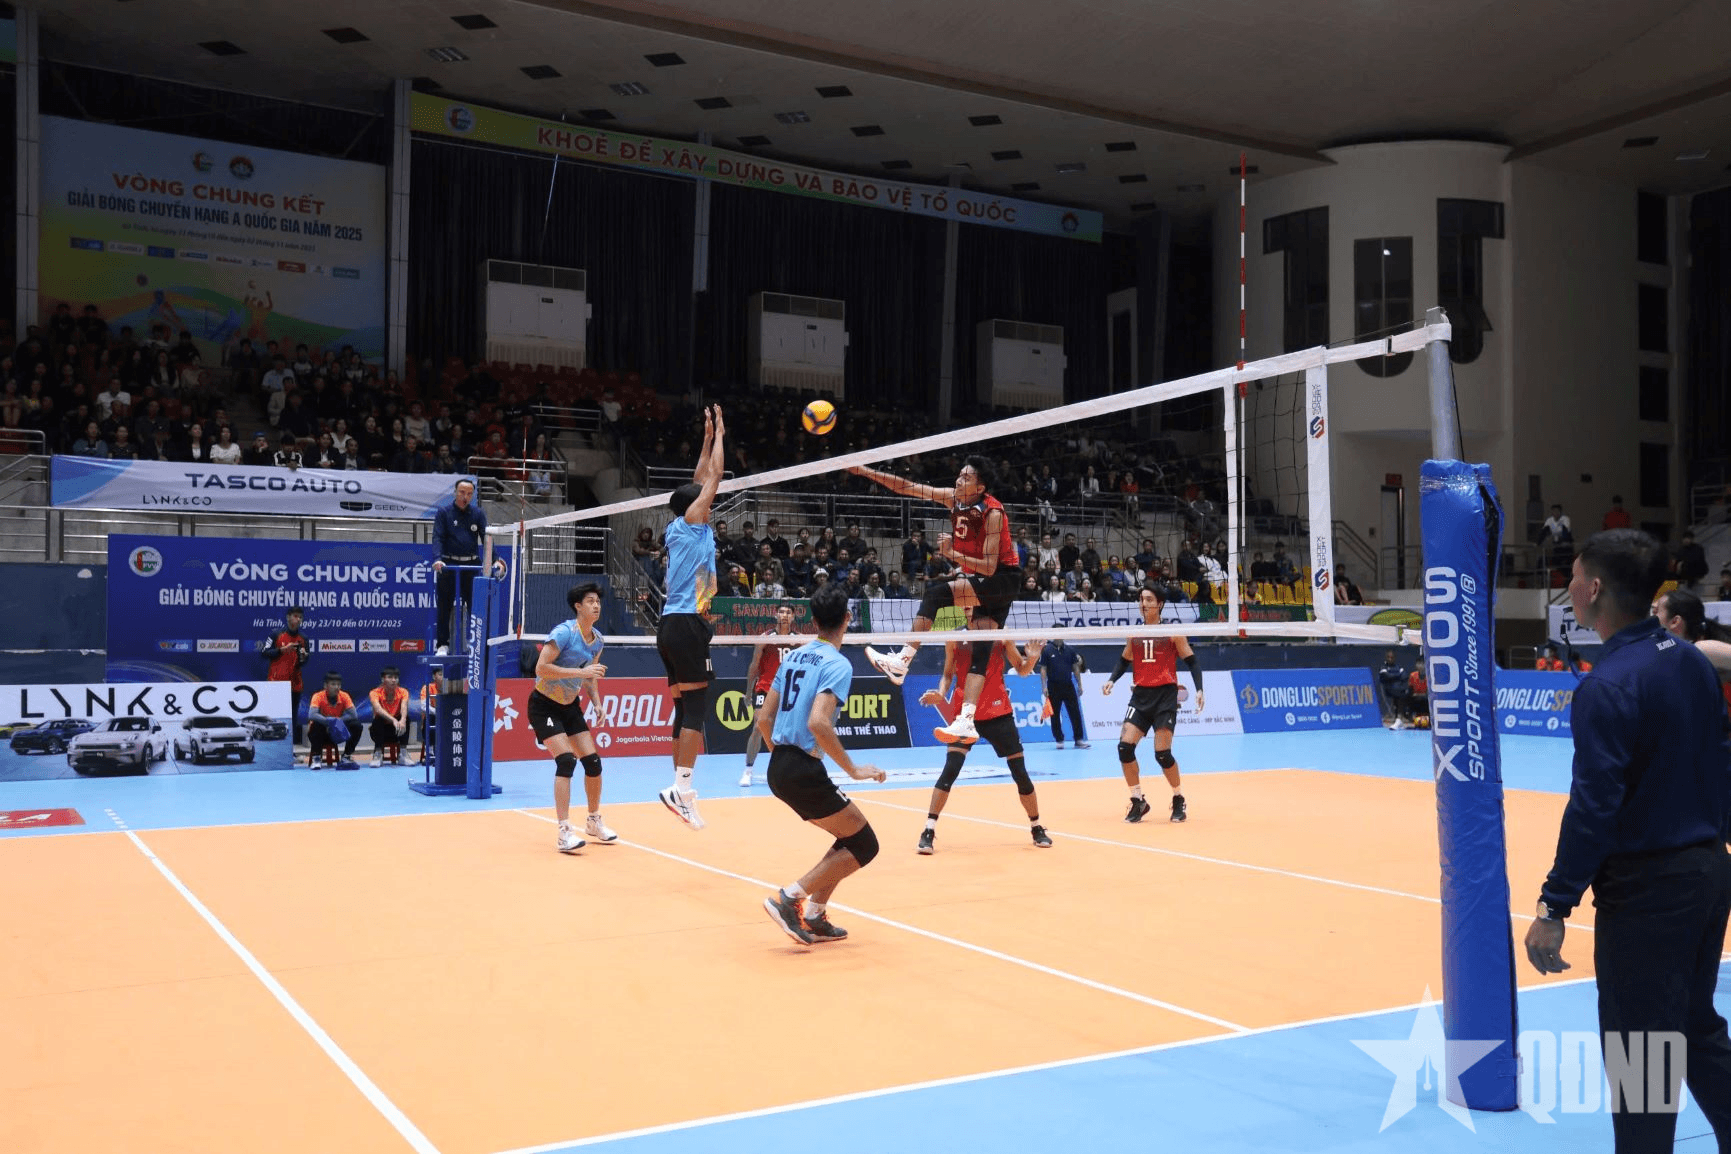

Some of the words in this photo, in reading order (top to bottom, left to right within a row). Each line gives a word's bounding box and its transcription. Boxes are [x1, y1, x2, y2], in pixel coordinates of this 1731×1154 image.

[619, 138, 653, 162] ĐỂ
[662, 148, 707, 171] XÂY
[717, 159, 785, 185] DỰNG
[887, 187, 912, 211] VỆ
[956, 199, 1017, 222] QUỐC
[112, 171, 185, 196] VÒNG
[192, 184, 275, 209] CHUNG
[283, 193, 325, 215] KẾT
[67, 187, 95, 208] GIẢI
[98, 192, 136, 213] BÓNG
[139, 199, 191, 219] CHUYỀN
[194, 206, 229, 224] HẠNG
[232, 211, 241, 226] A
[244, 211, 277, 230] QUỐC
[280, 217, 300, 233] GIA
[303, 219, 331, 237] NĂM
[334, 225, 362, 241] 2025
[184, 473, 287, 491] TASCO
[291, 478, 362, 494] AUTO
[955, 515, 968, 539] 5
[209, 557, 288, 581] VÒNG
[296, 564, 387, 583] CHUNG
[159, 583, 190, 606] GIẢI
[193, 585, 234, 606] BÓNG
[238, 585, 295, 607] CHUYỀN
[298, 591, 337, 611] HẠNG
[340, 591, 350, 607] A
[353, 586, 389, 609] QUỐC
[393, 592, 416, 608] GIA
[253, 618, 264, 627] Hà
[318, 618, 341, 628] 23/10
[342, 618, 357, 628] đến
[358, 618, 402, 628] 01/11/2025
[1142, 639, 1154, 659] 11
[1463, 636, 1479, 680] Since
[756, 694, 765, 706] 18
[782, 668, 806, 712] 15
[1261, 684, 1374, 709] DONGLUCSPORT.VN
[615, 734, 650, 744] Jogarbola
[651, 733, 673, 742] Vietna
[873, 725, 897, 735] THAO
[1464, 678, 1485, 781] SPORT
